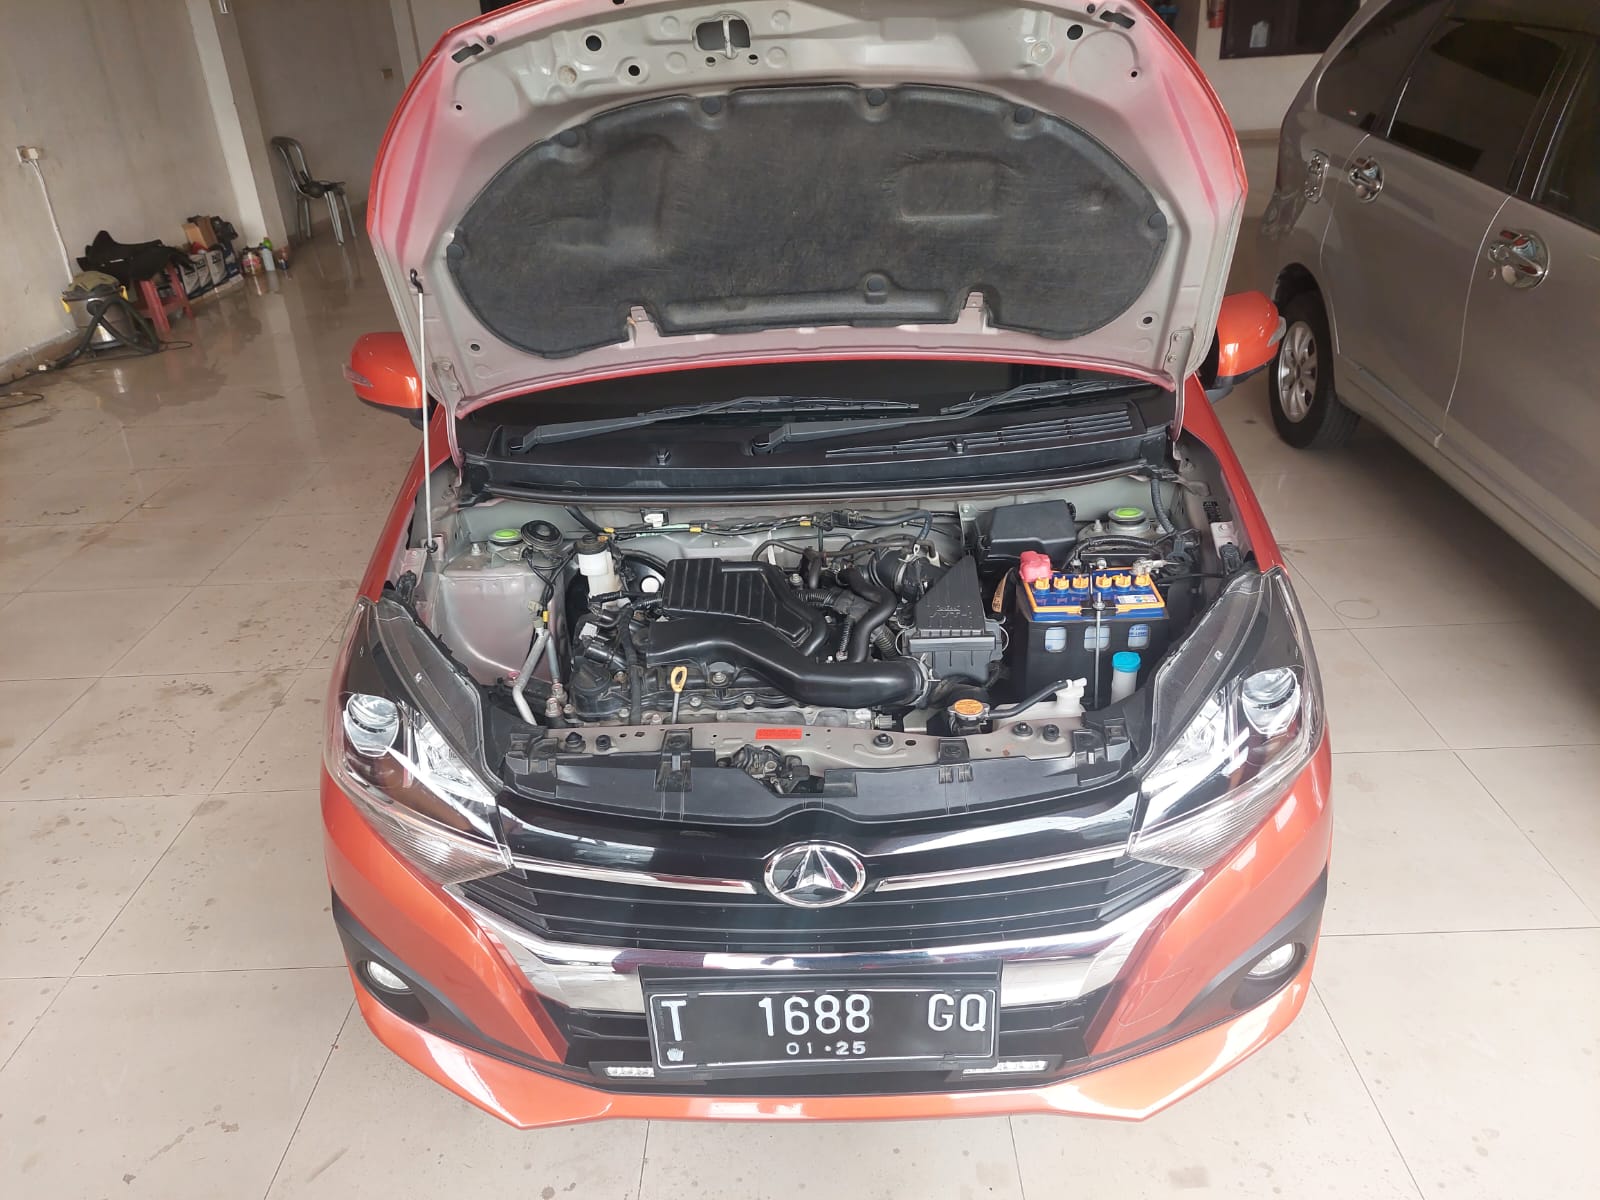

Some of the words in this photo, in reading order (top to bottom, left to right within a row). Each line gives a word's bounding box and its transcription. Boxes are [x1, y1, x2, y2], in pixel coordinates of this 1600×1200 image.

[660, 999, 687, 1042] T
[758, 993, 871, 1037] 1688
[927, 993, 987, 1033] GQ
